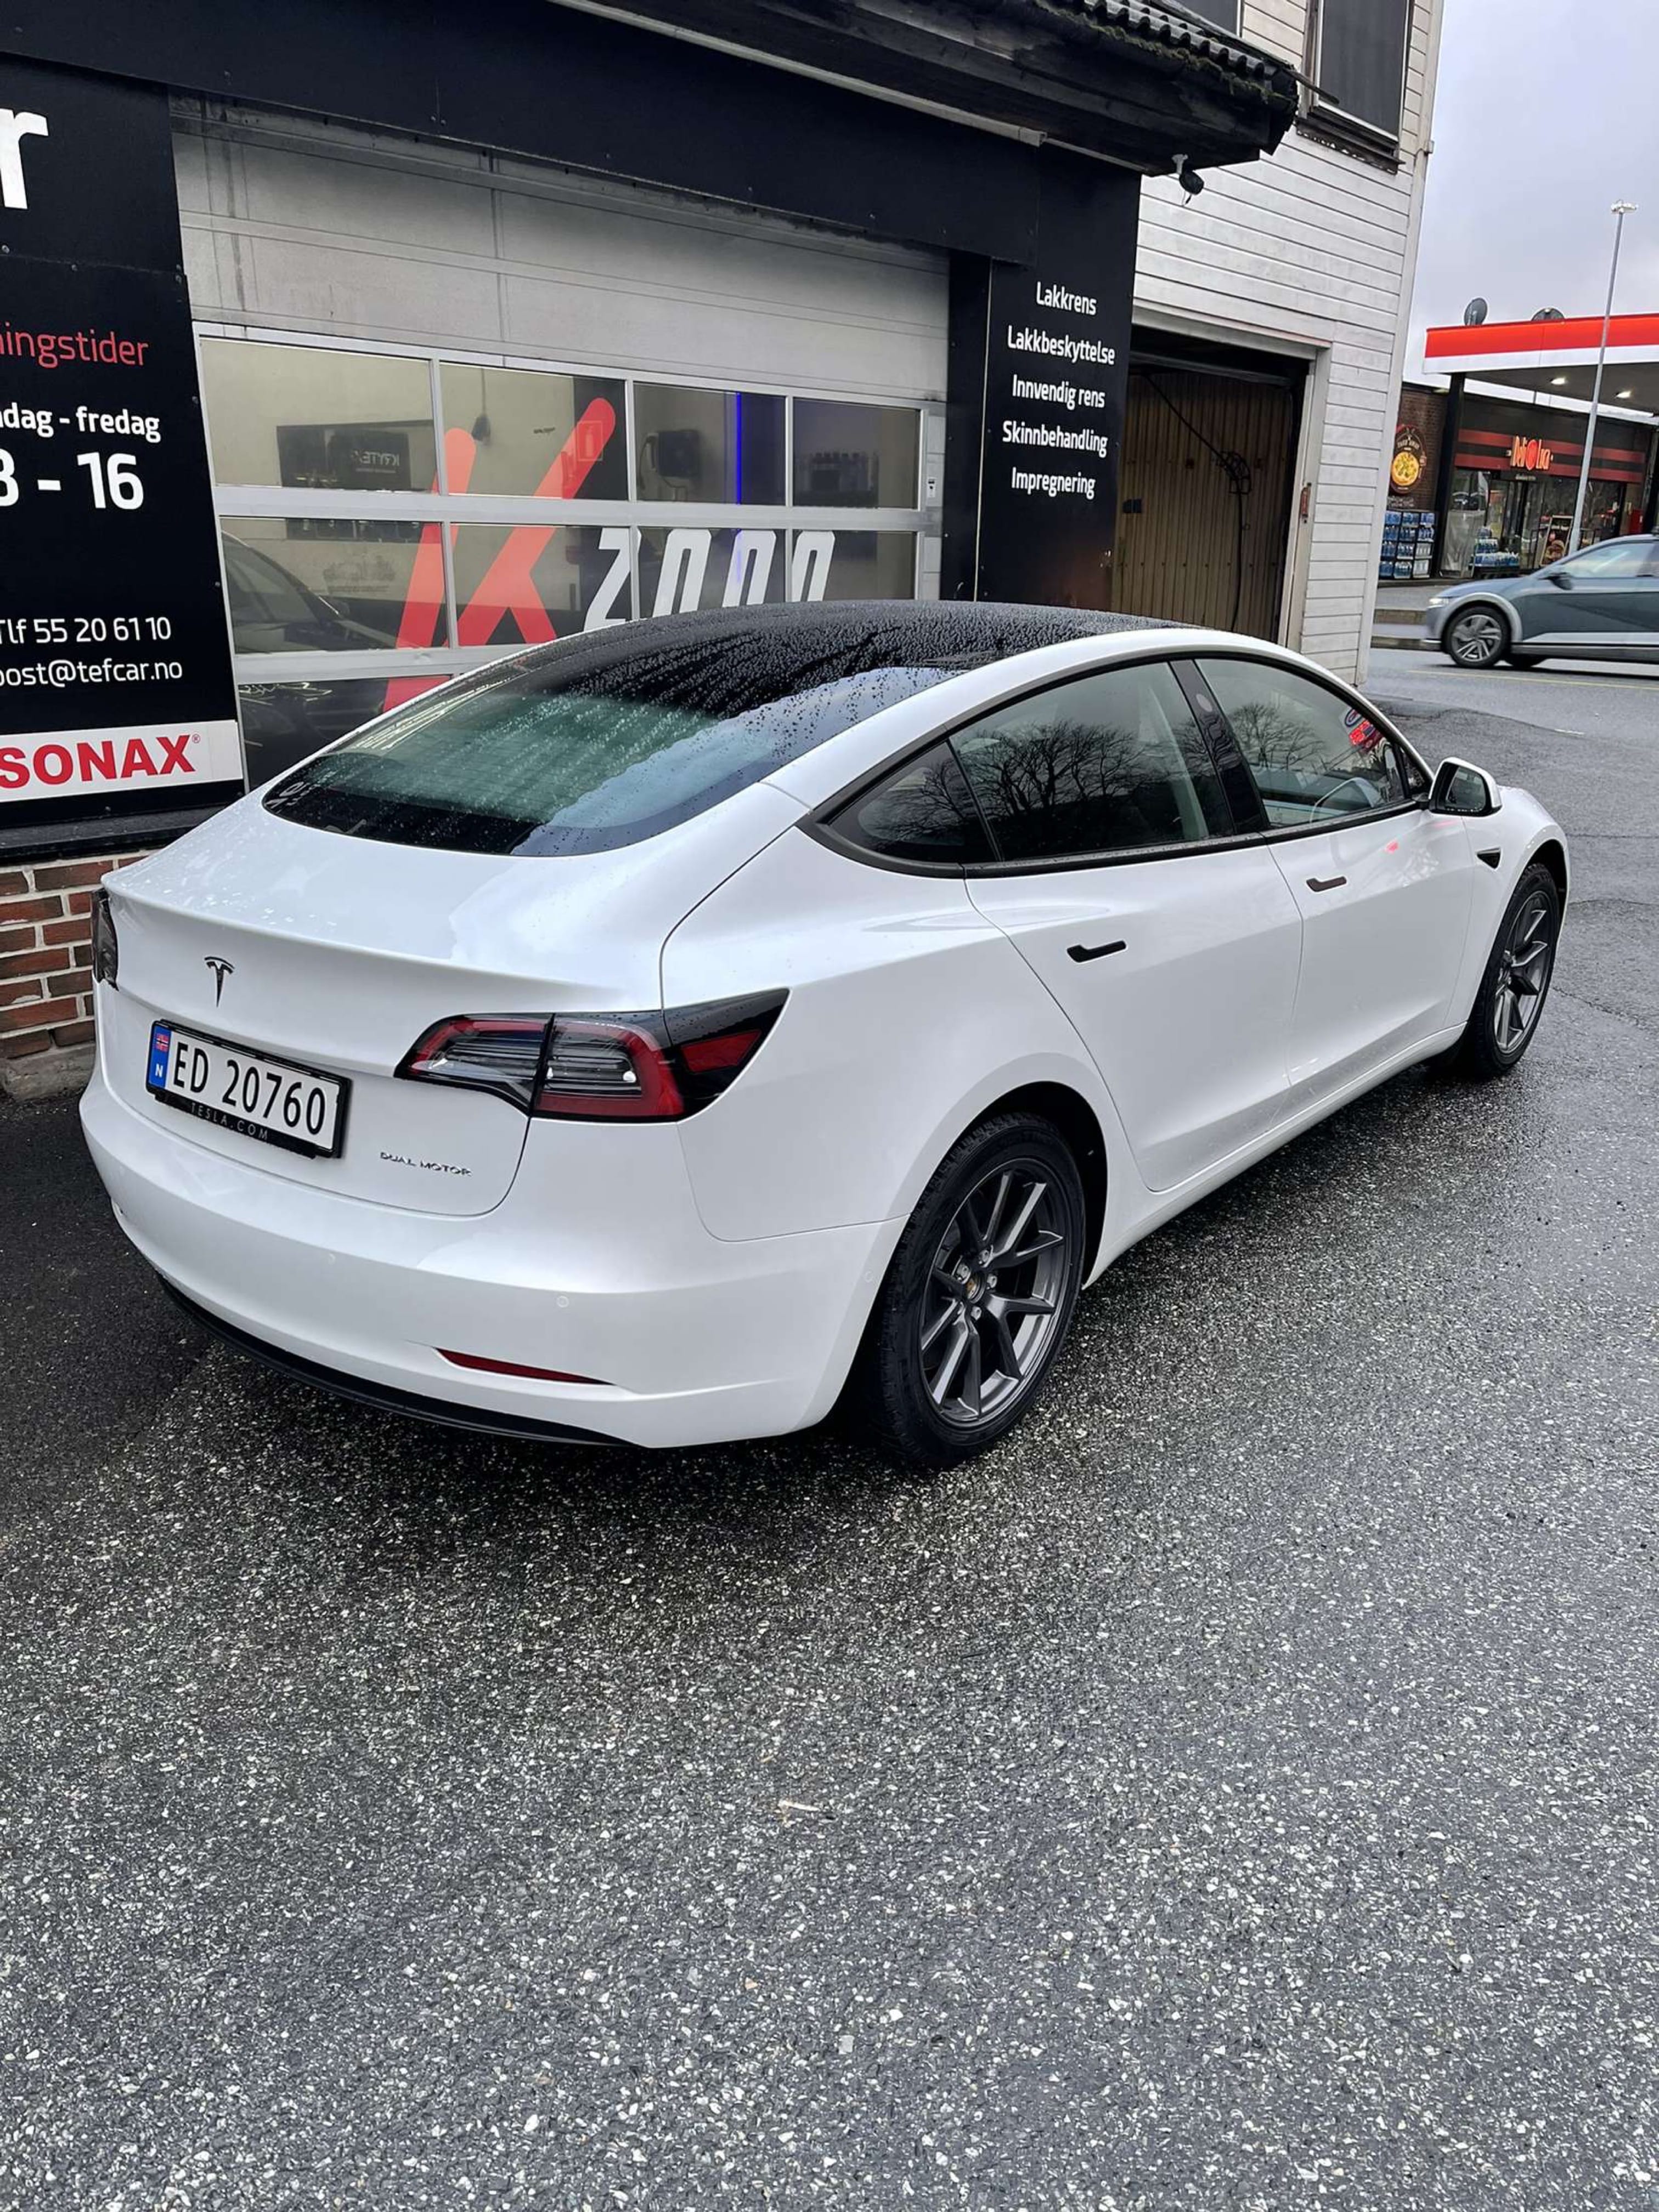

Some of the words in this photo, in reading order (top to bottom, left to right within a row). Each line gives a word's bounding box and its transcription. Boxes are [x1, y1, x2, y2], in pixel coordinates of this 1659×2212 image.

[1036, 281, 1097, 315] Lakkrens
[0, 321, 148, 368] ingstider
[1007, 325, 1115, 365] Lakkbeskyttelse
[1012, 374, 1076, 410] Innvendig
[1078, 388, 1105, 408] rens
[0, 402, 54, 438] dag
[76, 405, 161, 443] fredag
[1002, 420, 1108, 458] Skinnbehandling
[76, 452, 144, 510] 16
[1011, 466, 1096, 500] Impregnering
[33, 619, 68, 644] 55
[74, 618, 107, 642] 20
[113, 617, 140, 641] 61
[145, 617, 172, 640] 10
[155, 1063, 163, 1078] N
[173, 1041, 209, 1093] ED
[222, 1059, 326, 1135] 20760
[191, 1102, 269, 1140] TESLA.COM
[380, 1151, 416, 1167] DUAL
[420, 1159, 473, 1177] MOTOR
